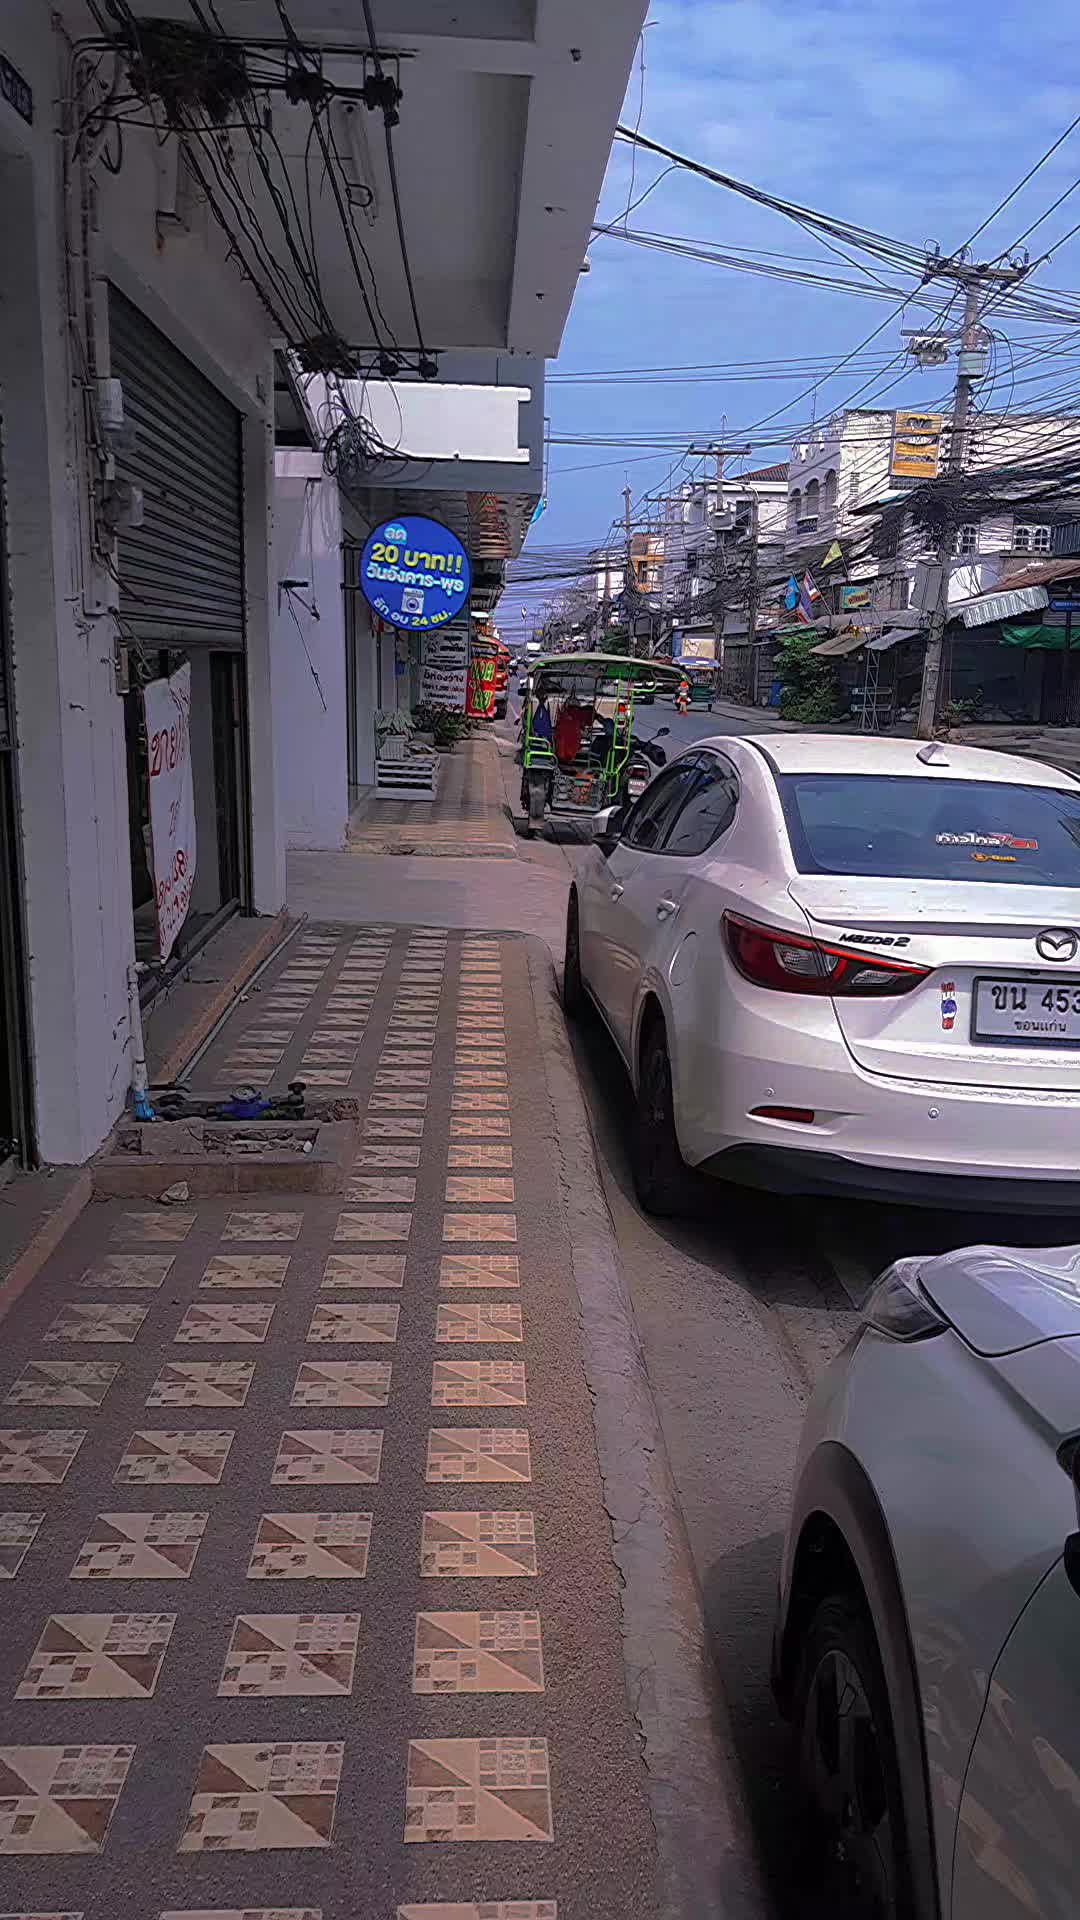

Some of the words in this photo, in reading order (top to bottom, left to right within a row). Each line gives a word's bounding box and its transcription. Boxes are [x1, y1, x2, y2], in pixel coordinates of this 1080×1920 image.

[371, 543, 399, 563] 20
[404, 549, 463, 574] บาท!!
[391, 611, 409, 625] อบ
[412, 616, 429, 627] 24
[991, 985, 1027, 1010] ขน
[1014, 1019, 1067, 1032] ขอนแก่น
